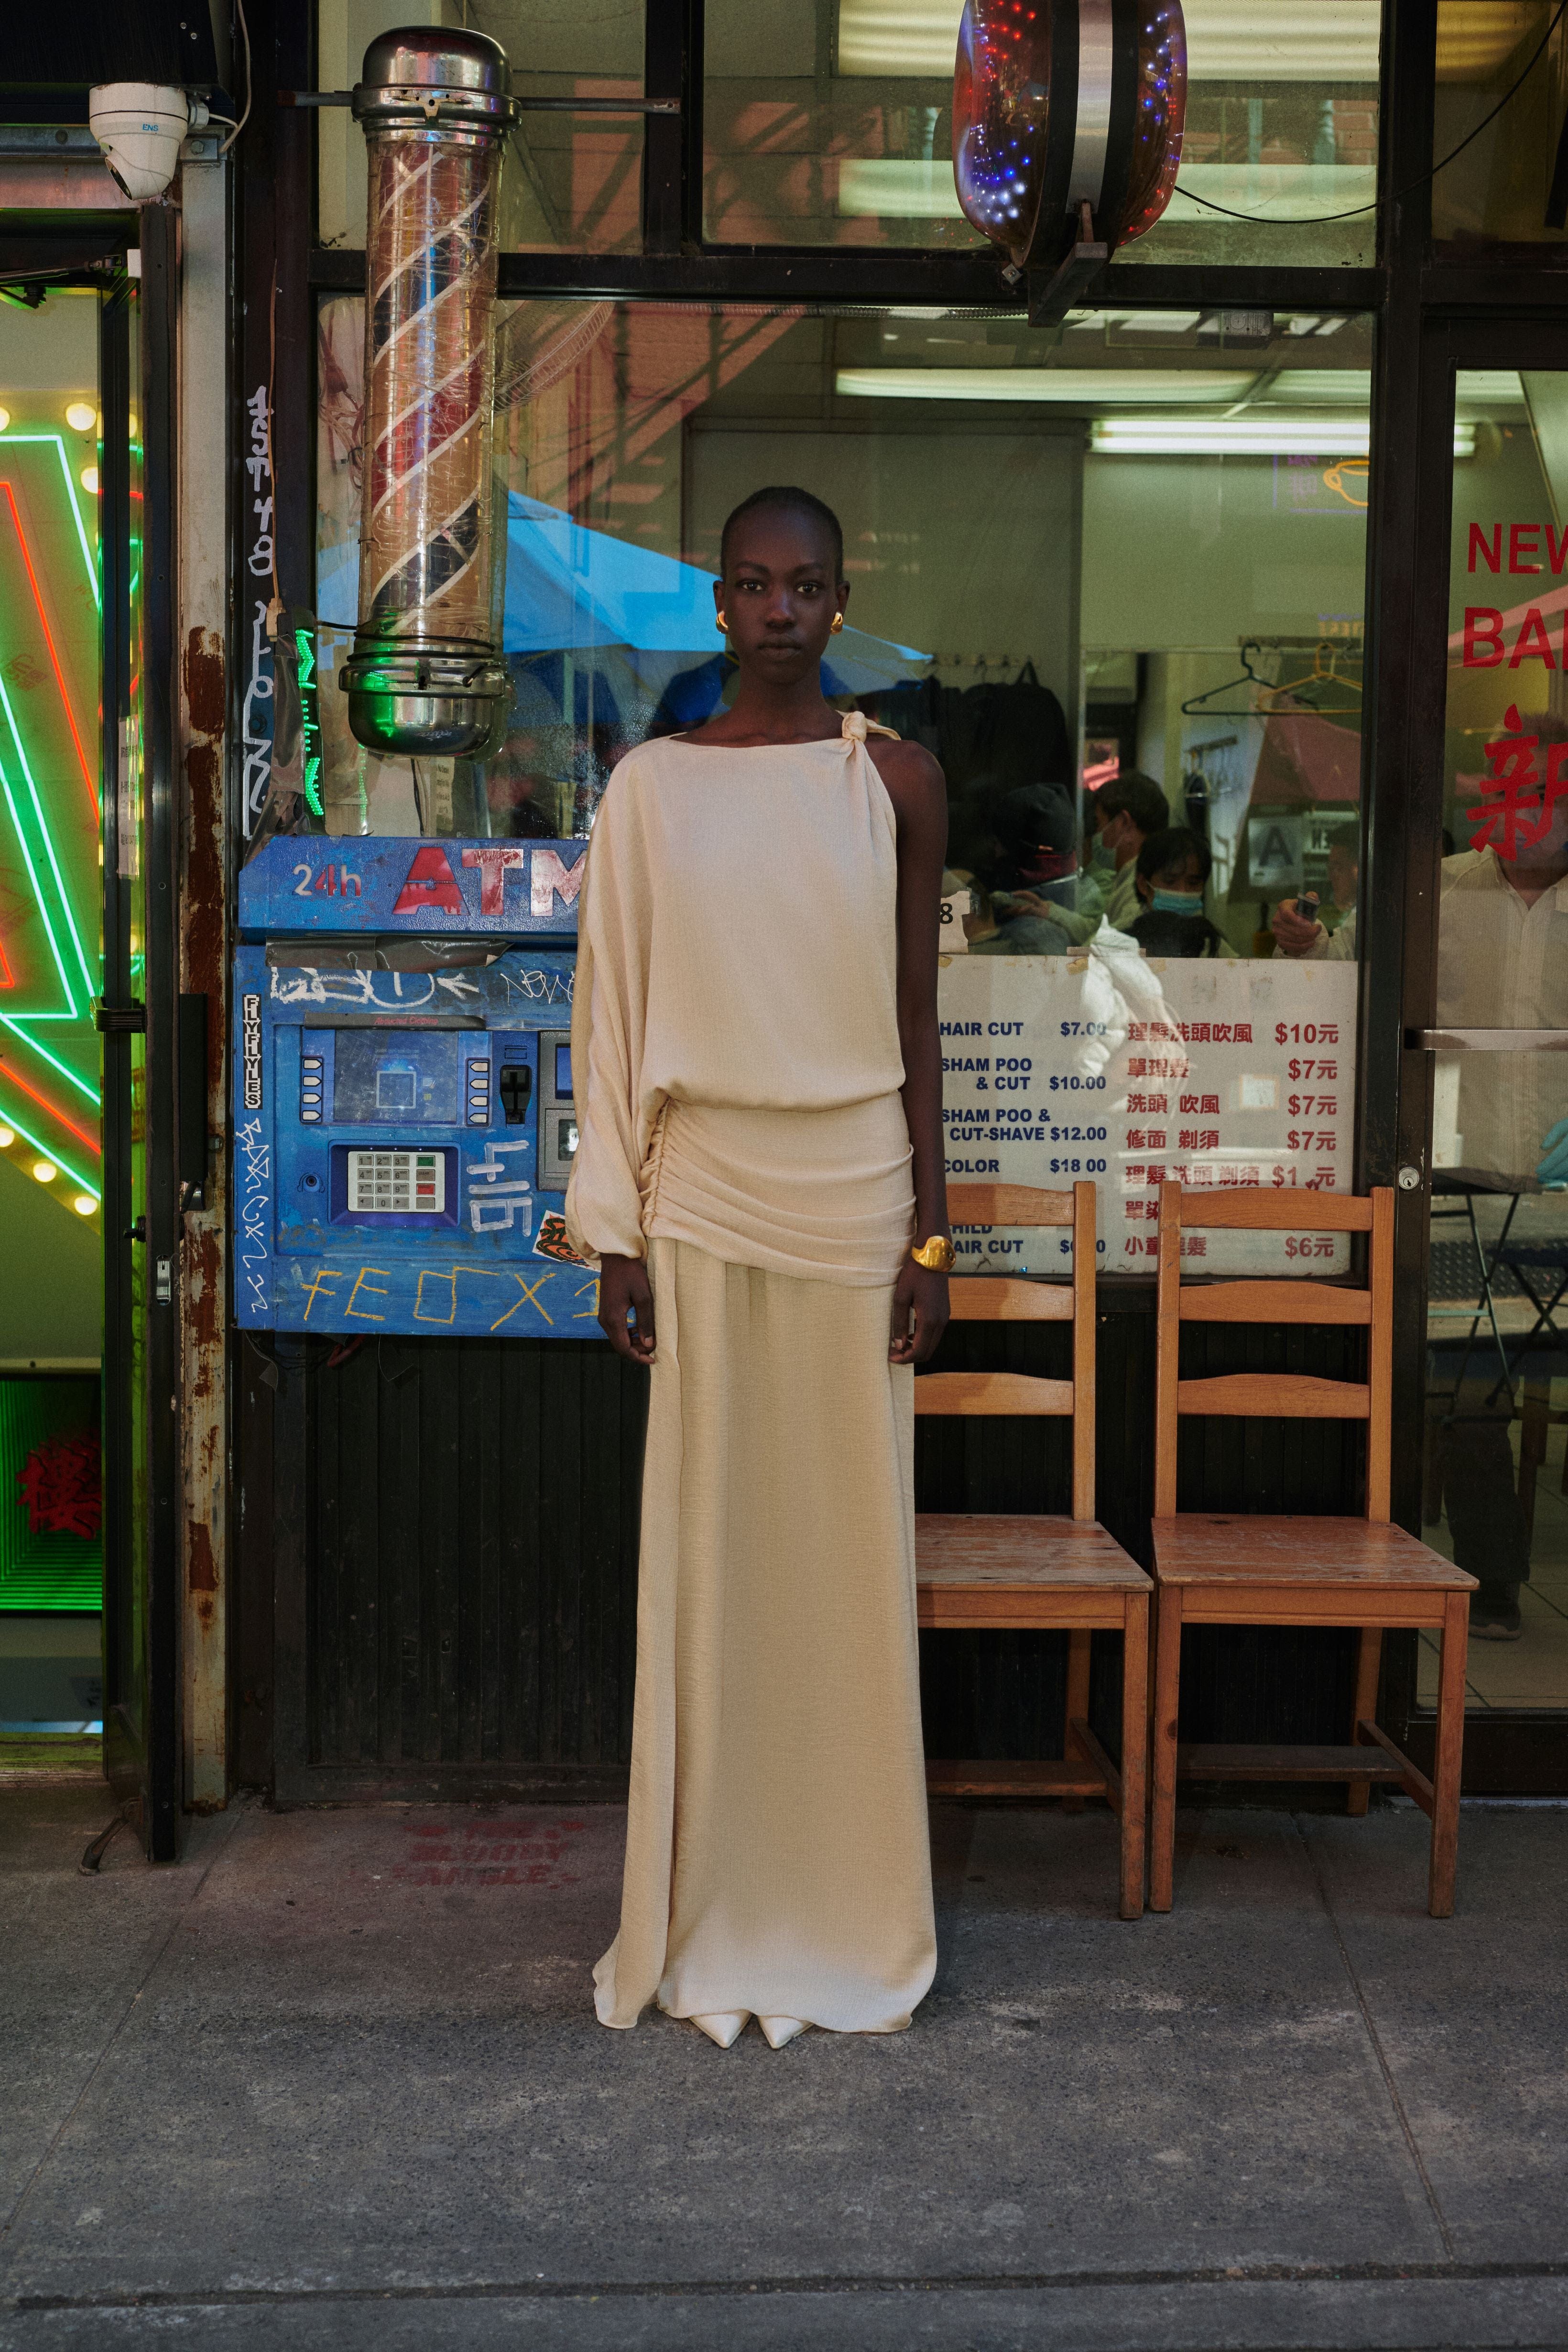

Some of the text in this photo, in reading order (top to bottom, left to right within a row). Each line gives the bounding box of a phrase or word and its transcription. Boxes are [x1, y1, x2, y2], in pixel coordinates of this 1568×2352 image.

[142, 123, 158, 131] ENS
[1463, 607, 1568, 669] BA
[293, 847, 588, 917] 24h ATM
[940, 1021, 1107, 1037] HAIR CUT $7.00
[1274, 1022, 1339, 1045] $10元
[942, 1058, 1033, 1071] SHAM POO
[1287, 1058, 1338, 1081] $7元
[976, 1075, 1107, 1091] & CUT $10.00
[1287, 1094, 1338, 1117] $7元
[943, 1109, 1051, 1122] SHAM POO &
[949, 1126, 1107, 1142] CUT-SHAVE $12.00
[1287, 1130, 1337, 1152] $7元
[1272, 1165, 1336, 1190] $1元
[949, 1226, 992, 1234] HILD
[954, 1240, 1024, 1253] AIR CUT
[1285, 1236, 1334, 1259] $6元
